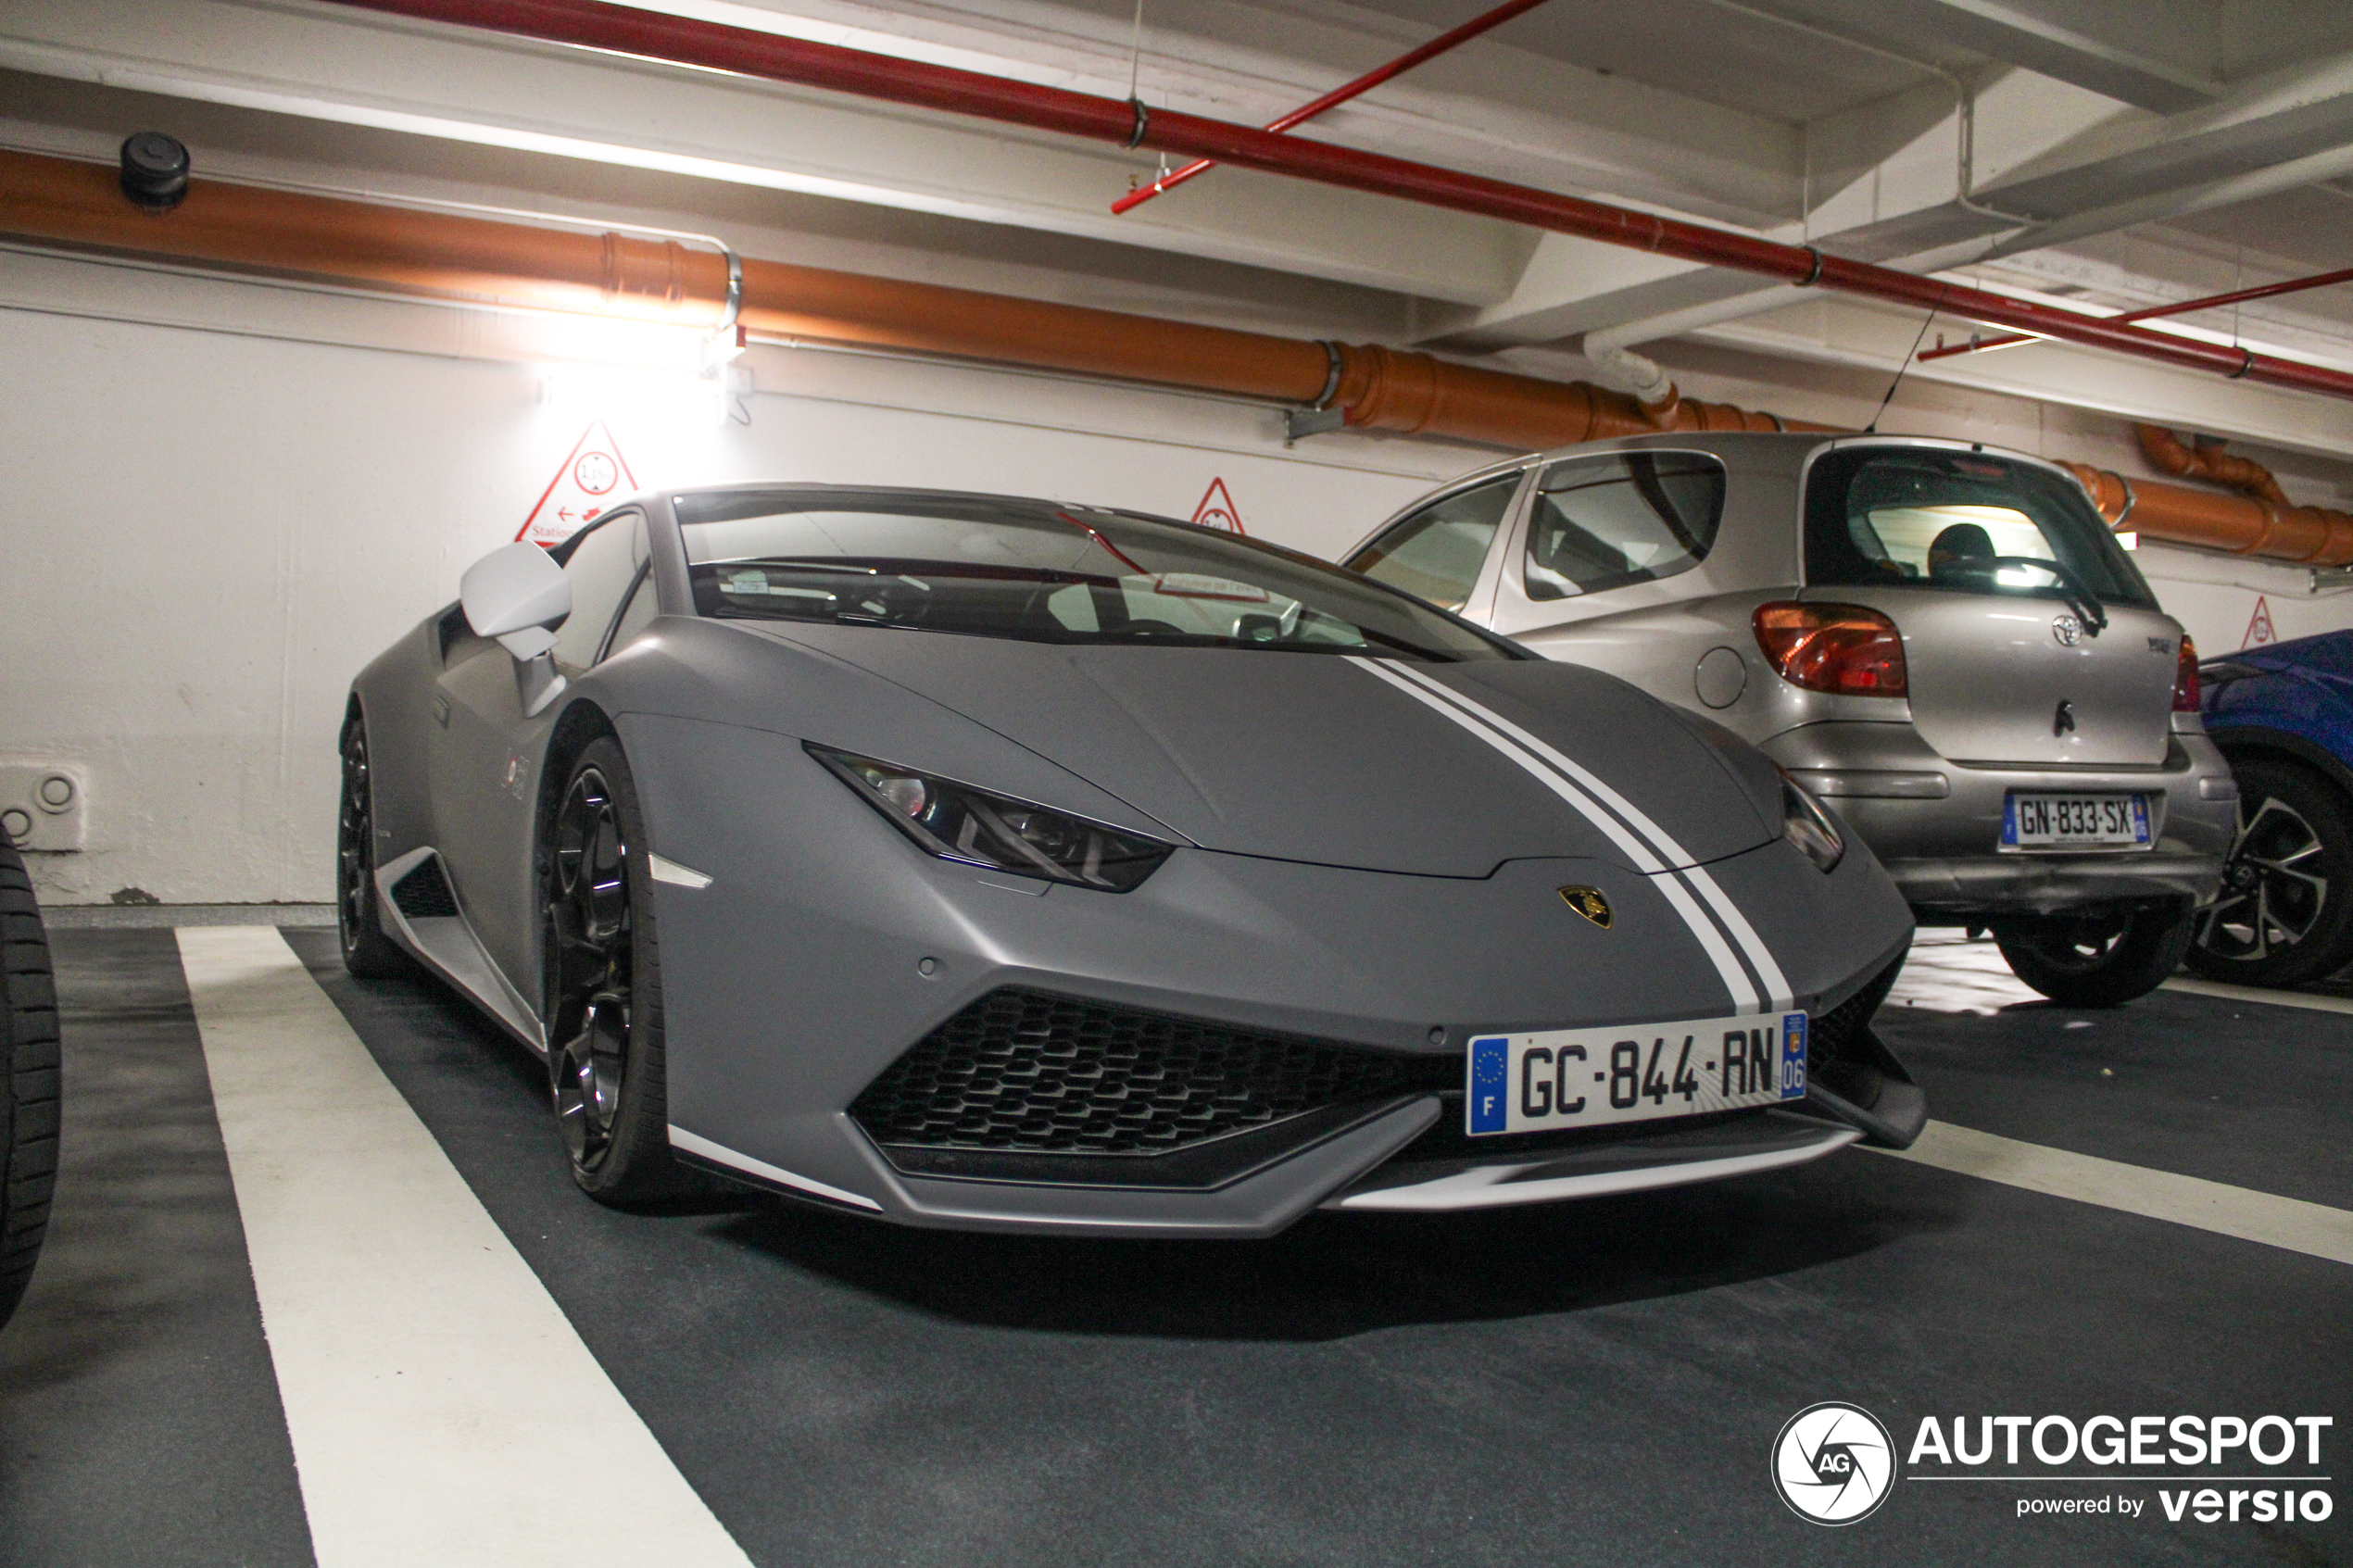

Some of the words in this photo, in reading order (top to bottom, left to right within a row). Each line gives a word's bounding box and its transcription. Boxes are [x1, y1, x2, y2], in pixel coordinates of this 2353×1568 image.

[2020, 800, 2131, 834] GN-833-SX
[1522, 1028, 1774, 1118] GC-844-RN
[1782, 1058, 1805, 1090] 06
[1483, 1097, 1494, 1116] F
